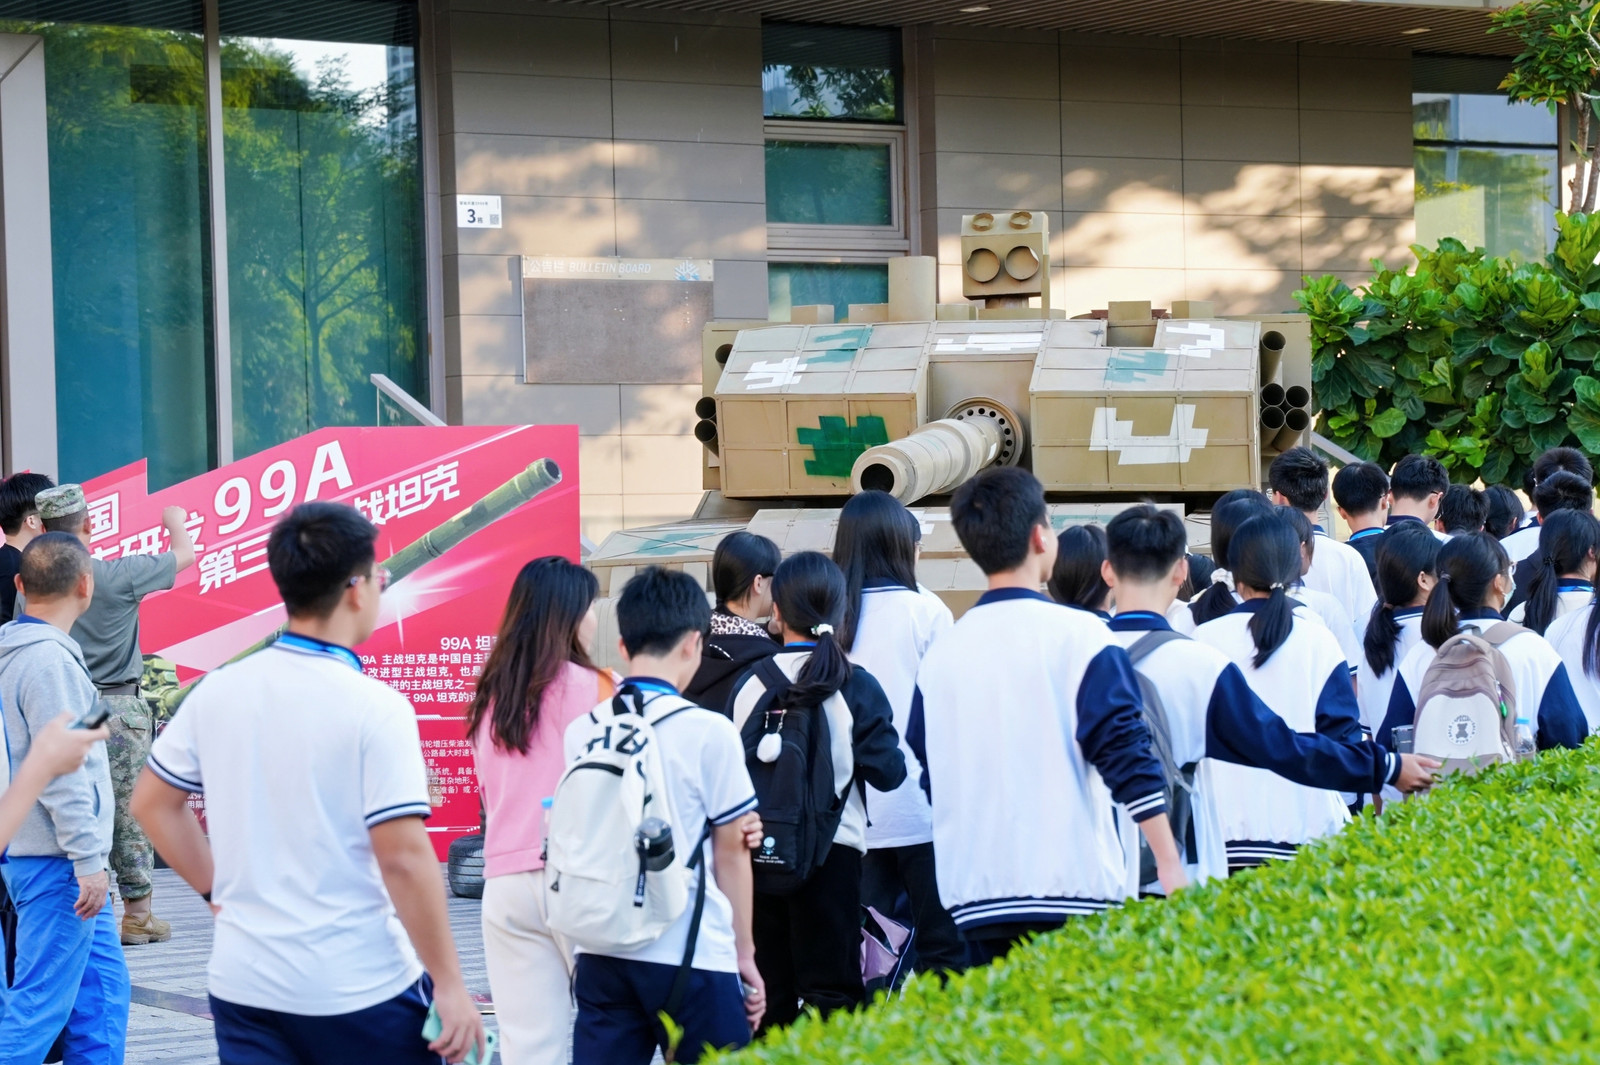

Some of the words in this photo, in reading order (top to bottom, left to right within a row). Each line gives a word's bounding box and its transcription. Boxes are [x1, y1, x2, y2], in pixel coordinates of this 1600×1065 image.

[569, 261, 616, 273] BULLETIN
[618, 263, 652, 274] BOARD
[213, 439, 354, 535] 99A
[440, 636, 472, 651] 99A
[475, 635, 498, 651] 坦
[362, 666, 482, 679] 改进型主战坦克，也是
[381, 679, 476, 691] 进的主战坦克之一
[413, 693, 434, 703] 99A
